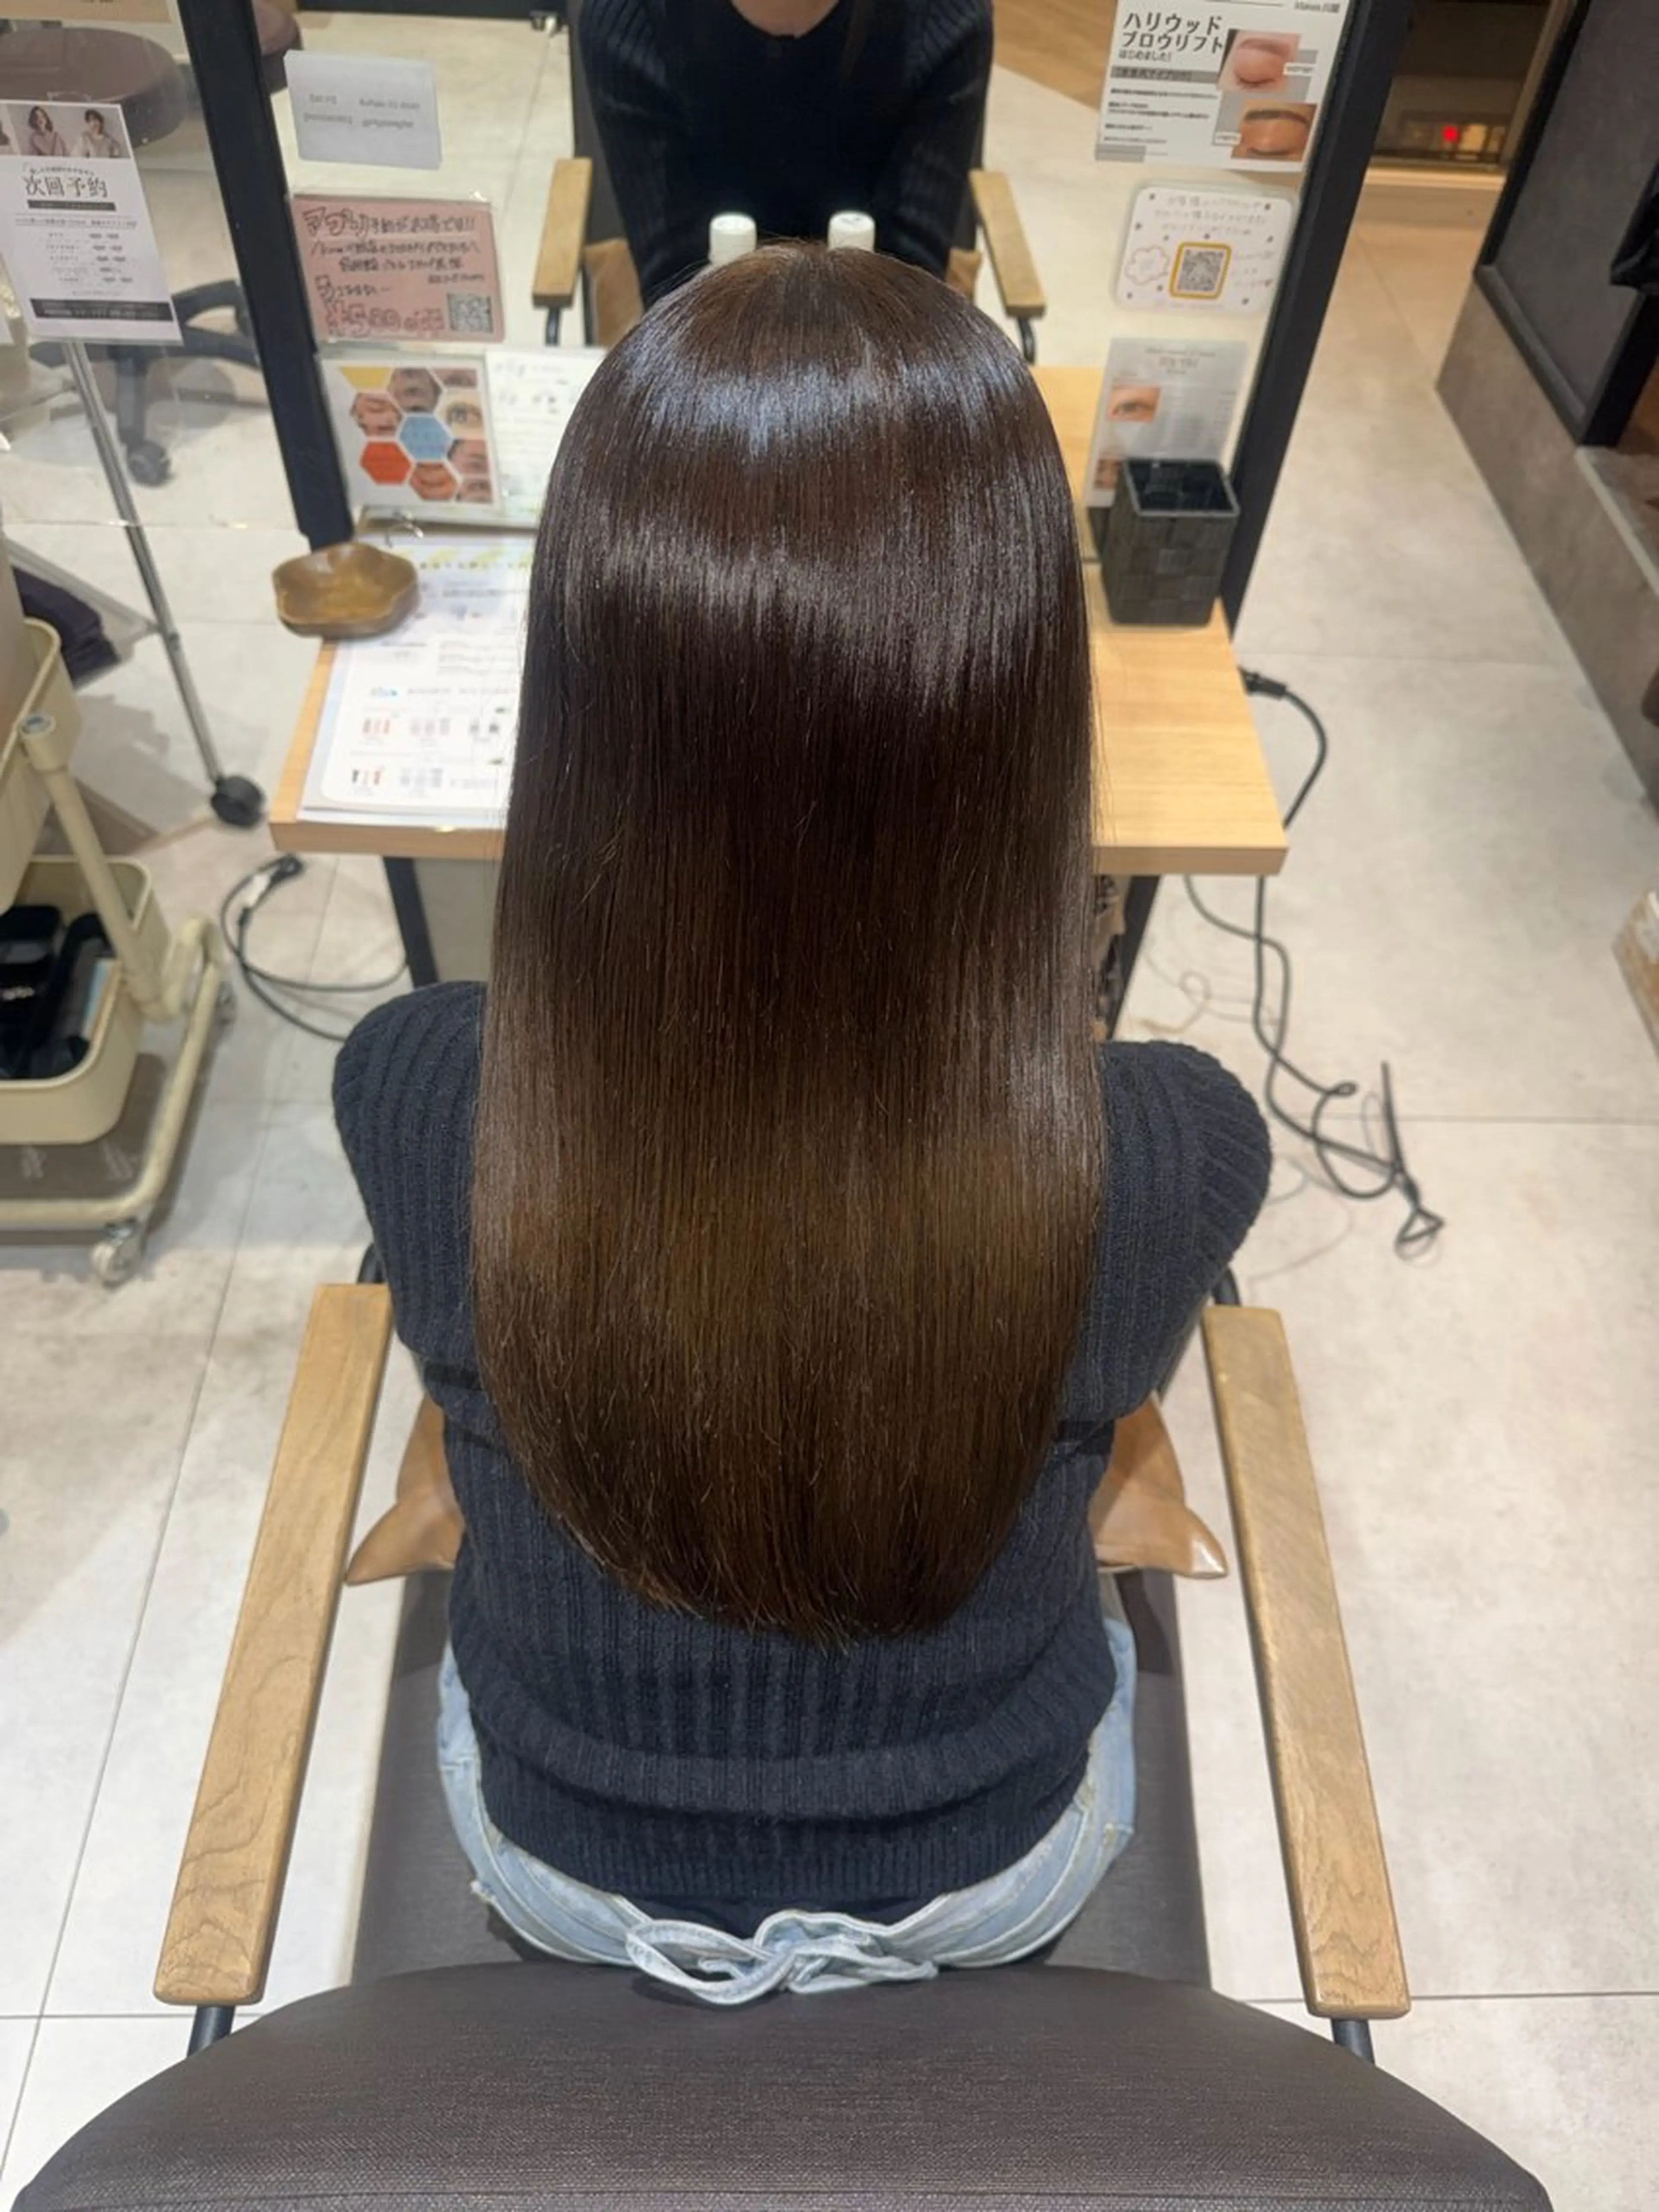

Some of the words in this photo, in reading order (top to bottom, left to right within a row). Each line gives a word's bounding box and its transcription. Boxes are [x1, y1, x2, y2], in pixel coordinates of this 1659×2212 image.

[1122, 12, 1223, 35] ハリウッド
[23, 174, 108, 198] 次回予約
